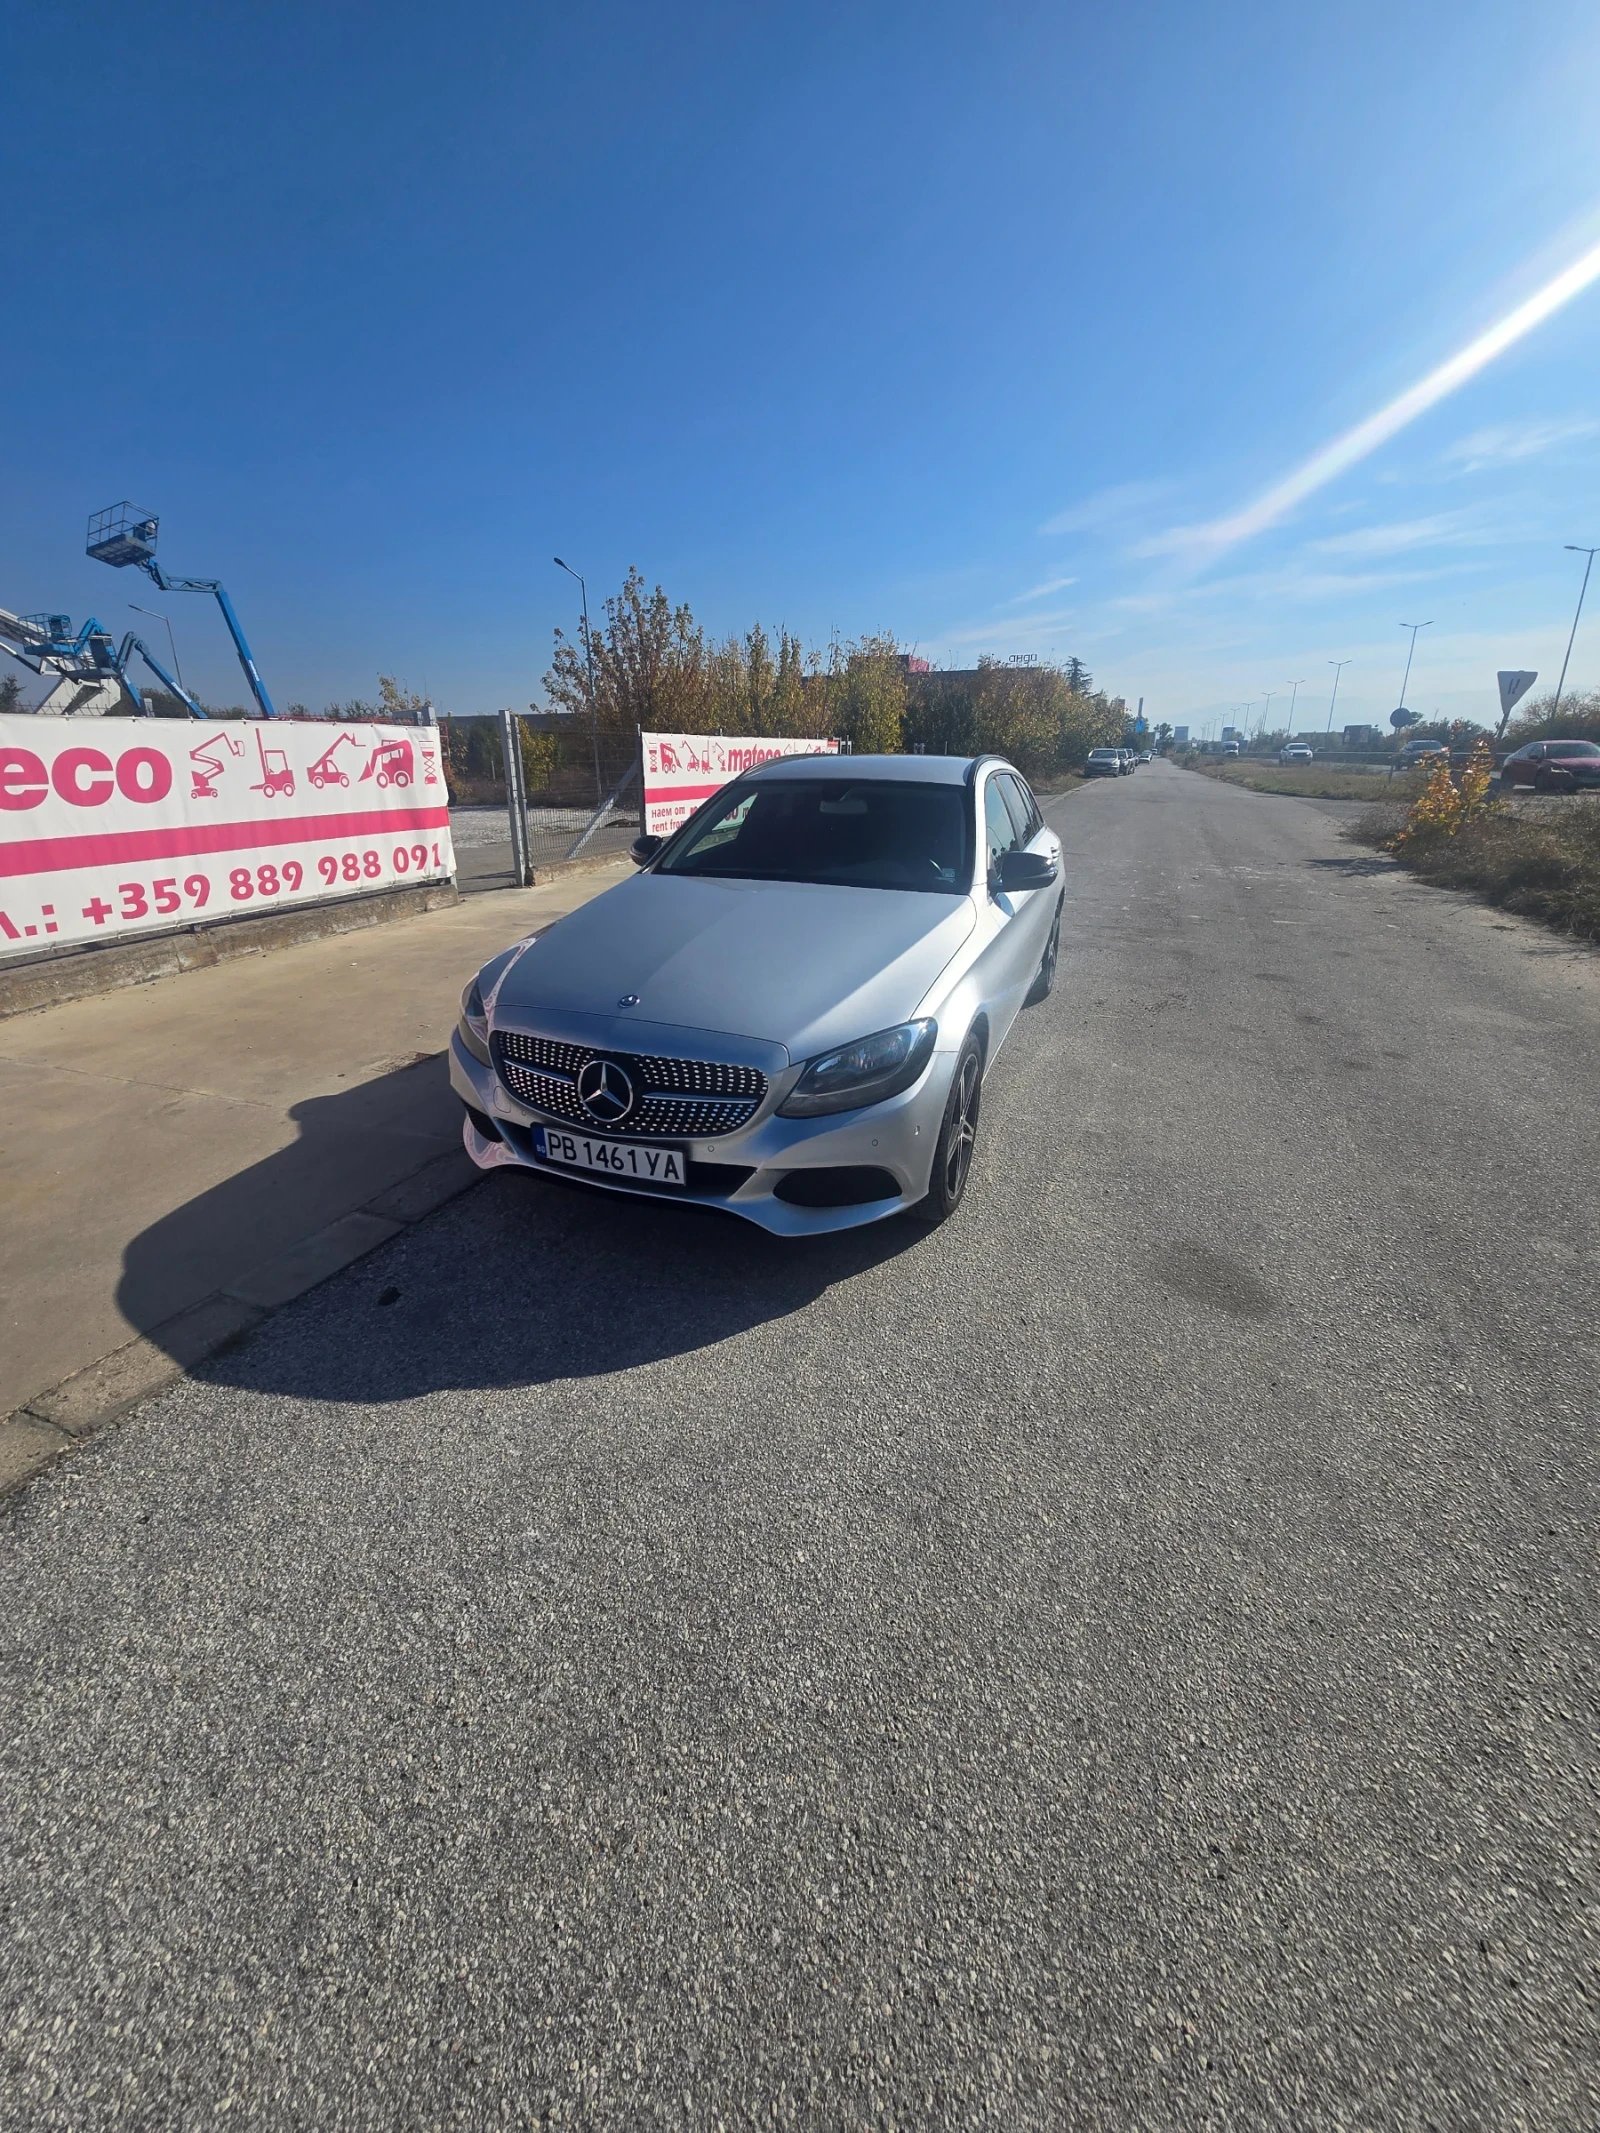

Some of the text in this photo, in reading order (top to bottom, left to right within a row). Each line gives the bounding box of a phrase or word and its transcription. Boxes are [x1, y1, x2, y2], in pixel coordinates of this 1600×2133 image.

[652, 821, 668, 833] rent
[82, 873, 211, 925] +359
[229, 861, 303, 900] 889
[318, 850, 381, 885] 988
[392, 842, 441, 873] 091
[547, 1132, 680, 1180] PB 1461 YA
